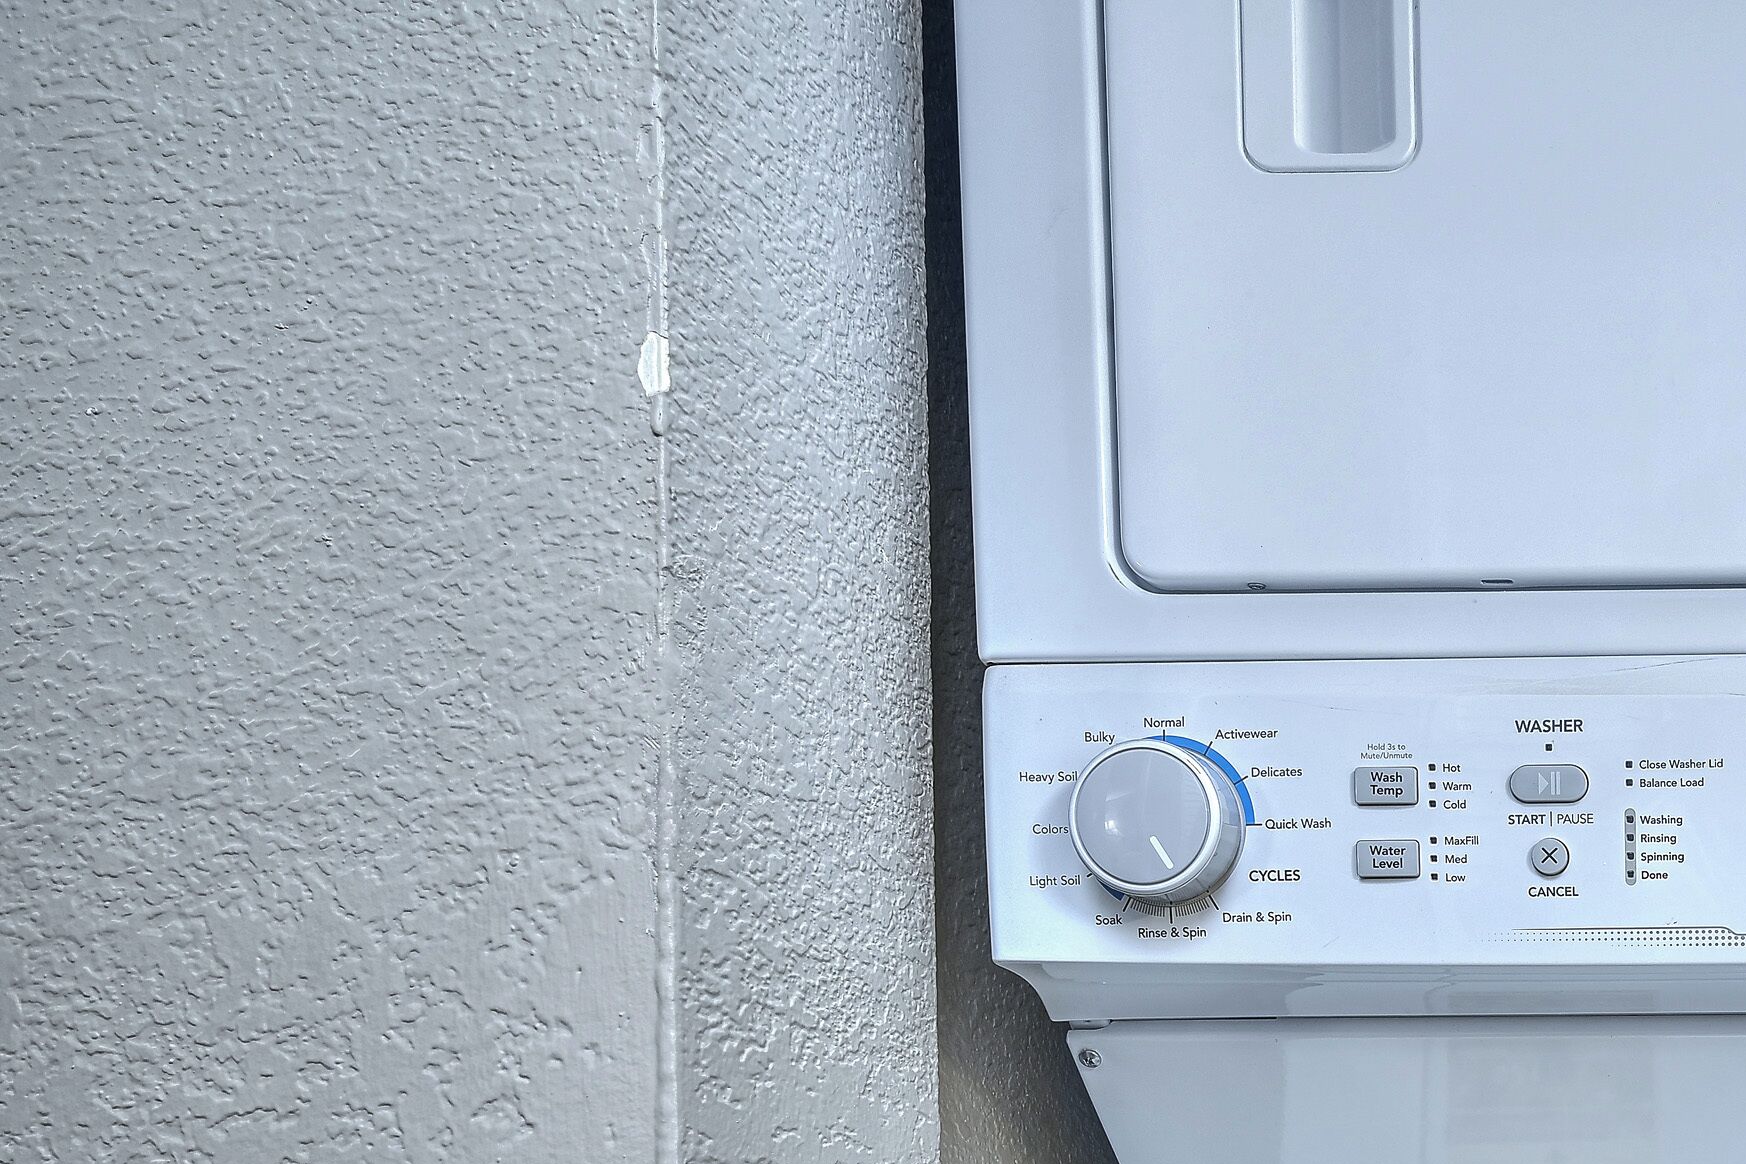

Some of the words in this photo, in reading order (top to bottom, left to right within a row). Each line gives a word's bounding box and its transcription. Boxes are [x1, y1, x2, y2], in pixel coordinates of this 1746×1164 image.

[1143, 716, 1185, 728] Normal
[1514, 719, 1583, 733] WASHER
[1084, 732, 1115, 745] Bulky
[1215, 728, 1278, 740] Activewear
[1367, 743, 1385, 751] Hold
[1387, 743, 1395, 751] 3s
[1397, 743, 1406, 751] to
[1360, 751, 1413, 760] Mute/Unmute
[1442, 763, 1461, 773] Hot
[1639, 759, 1666, 770] Close
[1669, 759, 1707, 769] Washer
[1709, 759, 1724, 769] Lid
[1019, 771, 1054, 783] Heavy
[1056, 770, 1078, 782] Soil
[1251, 766, 1303, 778] Delicates
[1370, 771, 1403, 784] Wash
[1442, 782, 1472, 791] Warm
[1639, 778, 1677, 788] Balance
[1680, 778, 1704, 787] Load
[1370, 784, 1404, 798] Temp
[1443, 800, 1467, 809] Cold
[1265, 818, 1299, 830] Quick
[1301, 818, 1332, 829] Wash
[1508, 814, 1546, 825] START
[1557, 813, 1594, 824] PAUSE
[1640, 815, 1683, 827] Washing
[1032, 824, 1069, 835] Colors
[1444, 836, 1479, 846] MaxFill
[1640, 834, 1677, 845] Rinsing
[1370, 845, 1406, 857] Water
[1372, 858, 1403, 869] Level
[1445, 855, 1468, 864] Med
[1640, 852, 1685, 864] Spinning
[1030, 875, 1058, 887] Light
[1060, 875, 1081, 886] Soil
[1249, 870, 1301, 882] CYCLES
[1445, 873, 1466, 882] Low
[1641, 870, 1668, 880] Done
[1528, 886, 1579, 897] CANCEL
[1095, 914, 1123, 926] Soak
[1222, 912, 1253, 923] Drain
[1255, 912, 1265, 923] &
[1267, 911, 1292, 924] Spin
[1138, 927, 1168, 939] Rinse
[1170, 927, 1180, 939] &
[1182, 927, 1207, 940] Spin
